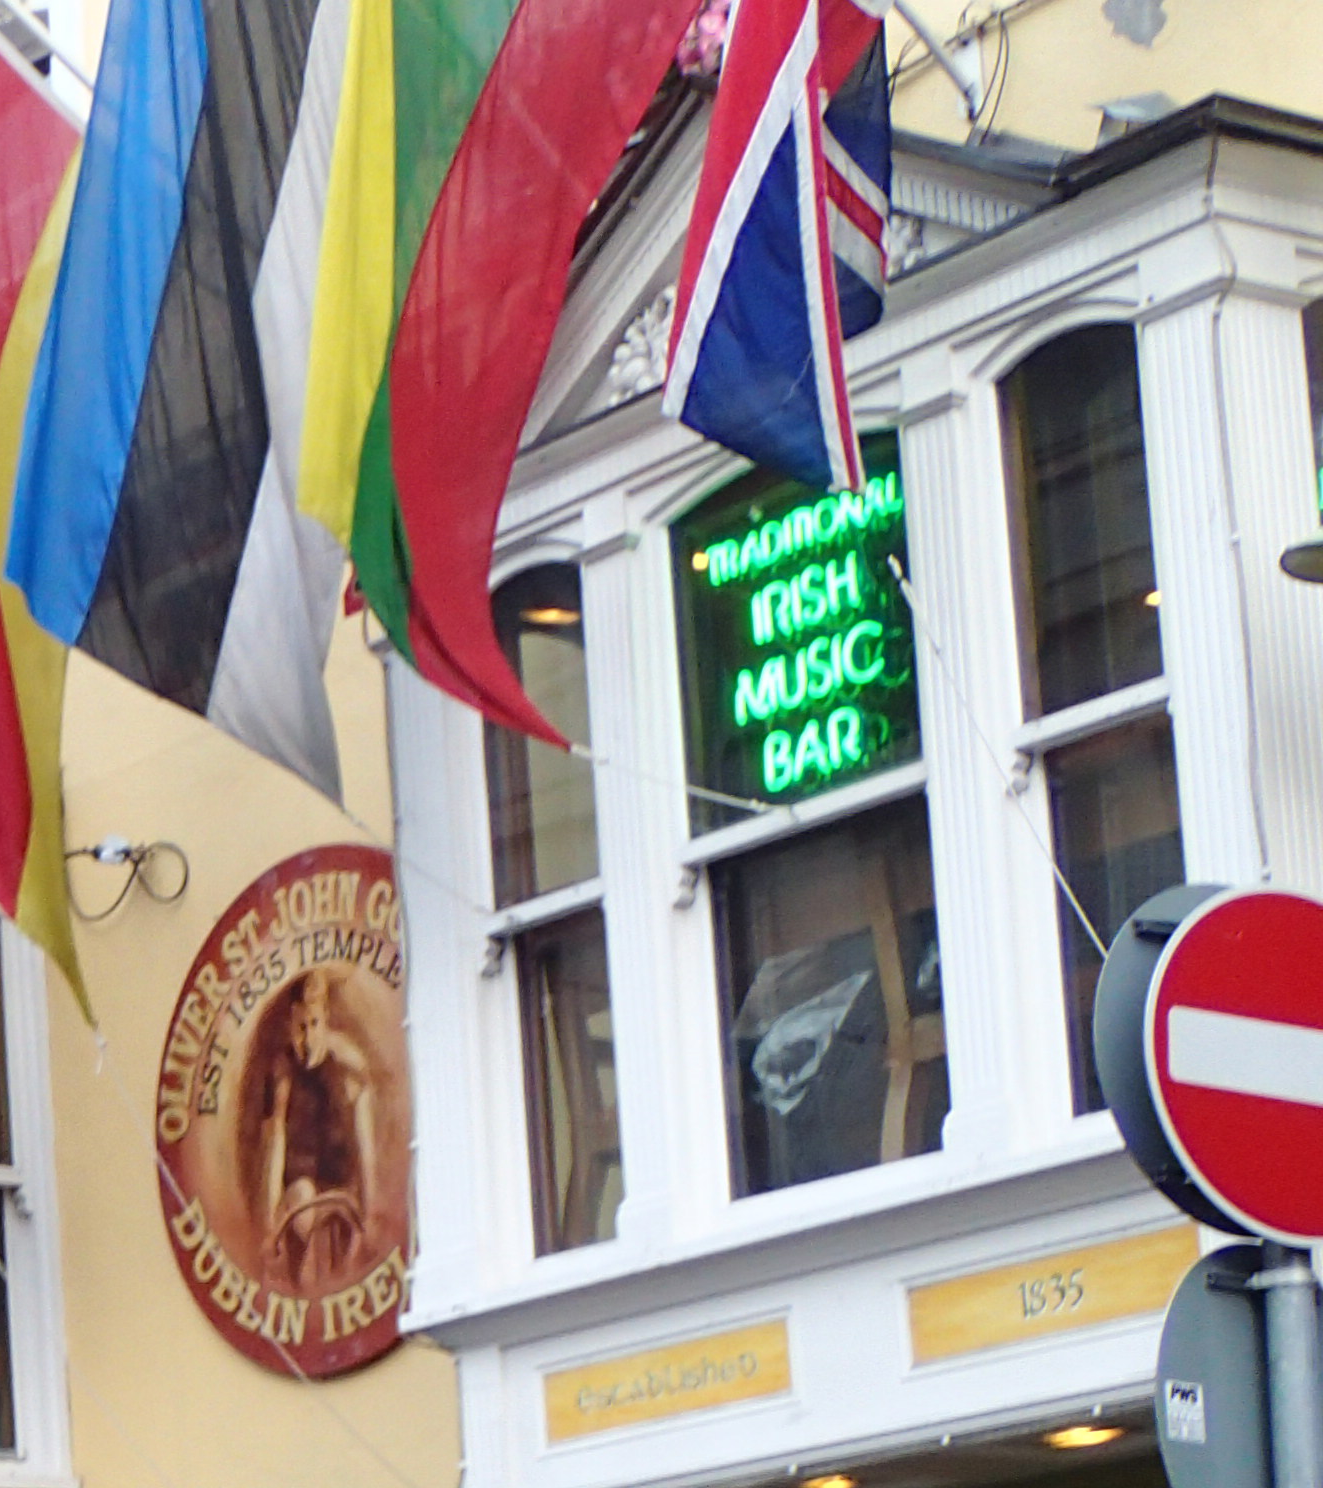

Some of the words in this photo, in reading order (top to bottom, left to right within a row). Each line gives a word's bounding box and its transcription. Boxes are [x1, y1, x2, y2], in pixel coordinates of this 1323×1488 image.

[705, 471, 903, 586] TRADITIONAL
[751, 550, 861, 645] IRISH
[734, 619, 885, 727] MUSIC
[763, 706, 861, 793] BAR
[157, 963, 233, 1143] OLIVER
[269, 870, 361, 940] JOHN
[171, 1196, 310, 1345] DUBLIN
[1017, 1268, 1085, 1320] 1835
